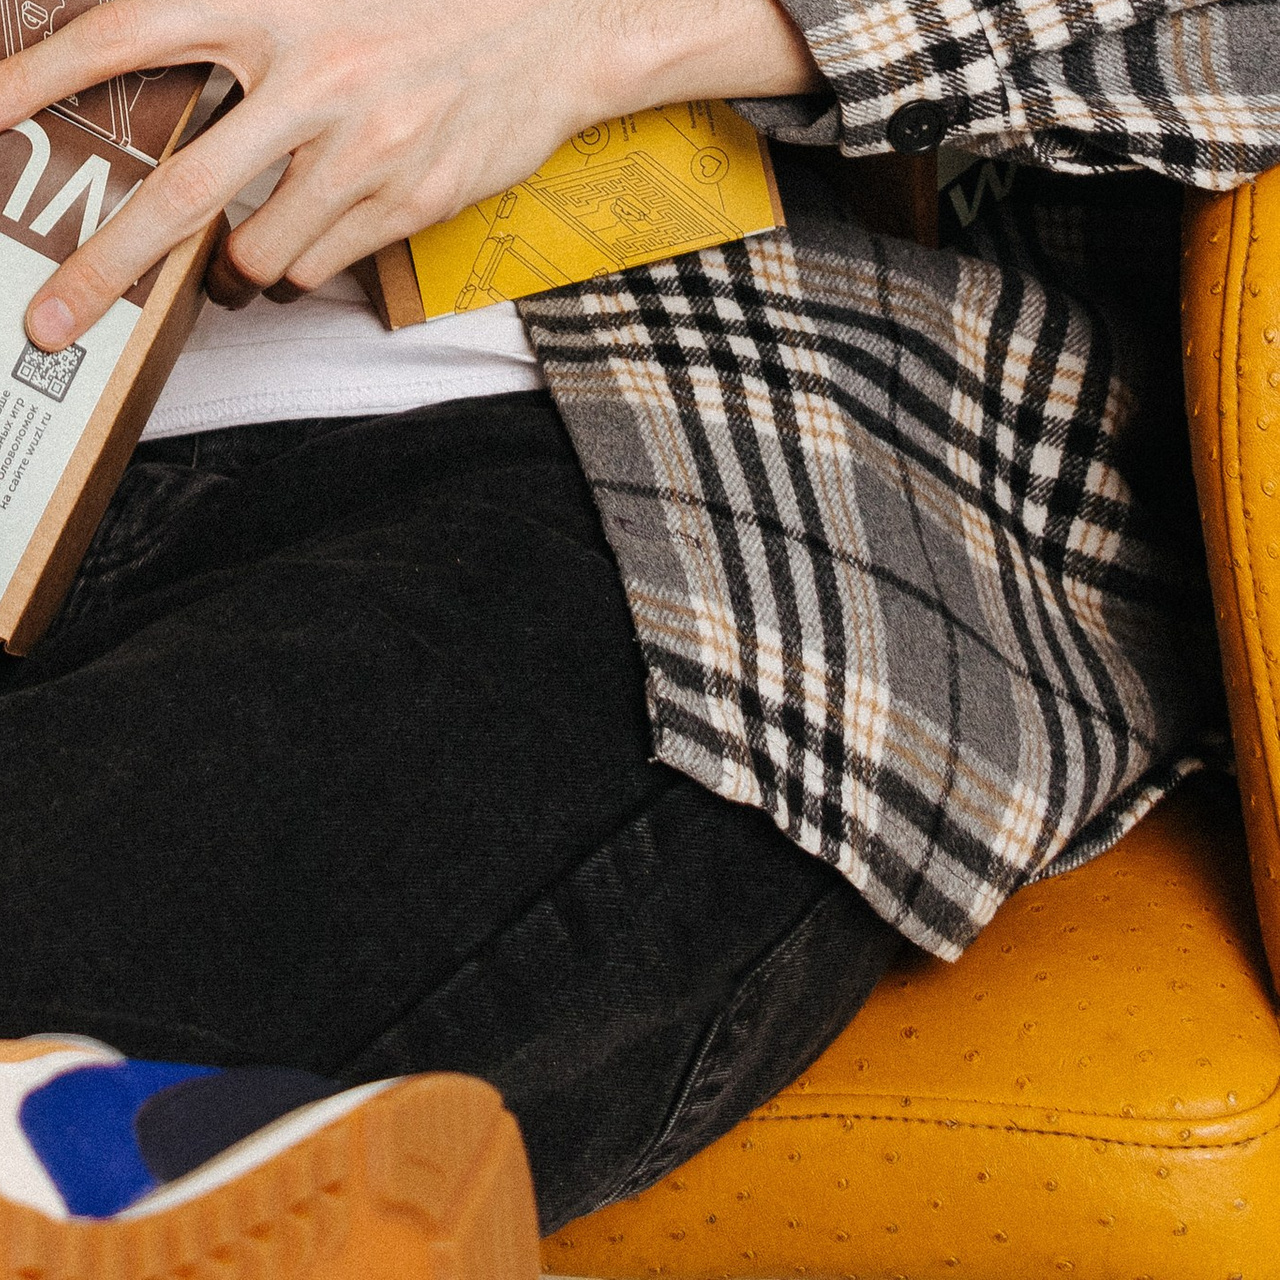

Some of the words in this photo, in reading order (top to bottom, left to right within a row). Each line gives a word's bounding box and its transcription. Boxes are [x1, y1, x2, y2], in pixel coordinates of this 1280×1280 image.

[9, 397, 25, 419] игр
[0, 494, 12, 510] на
[8, 457, 29, 492] сайте
[25, 411, 52, 456] wuzl.ru
